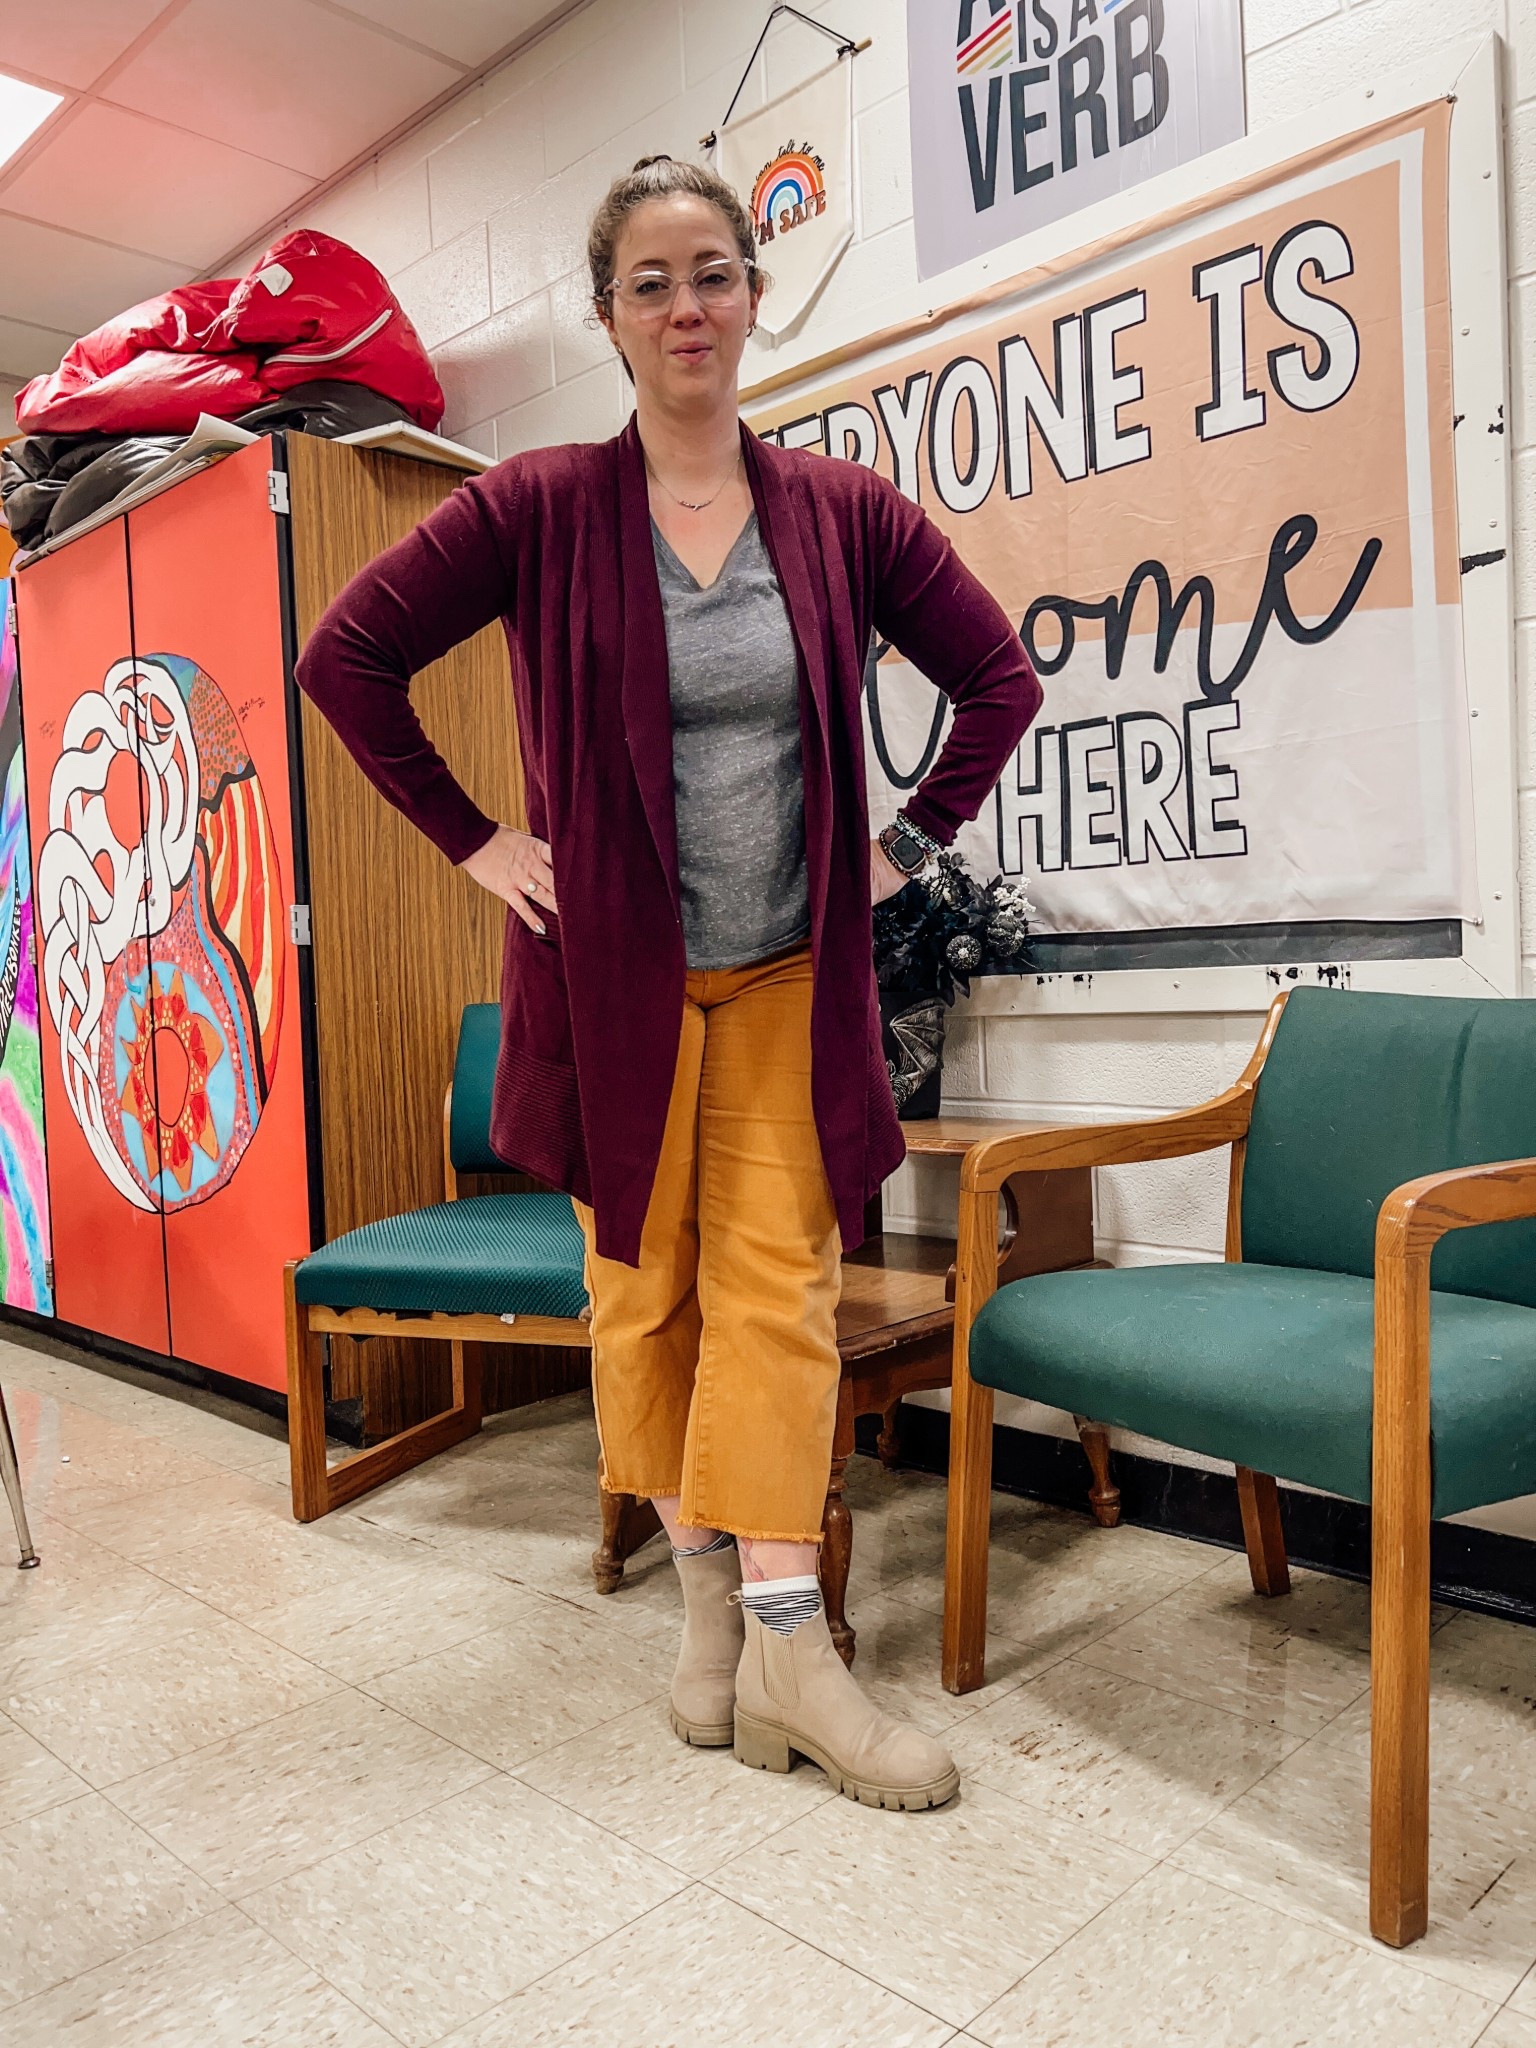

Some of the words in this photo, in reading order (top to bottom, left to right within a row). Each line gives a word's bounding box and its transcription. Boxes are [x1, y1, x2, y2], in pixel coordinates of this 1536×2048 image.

[776, 139, 795, 161] talk
[798, 142, 814, 155] to
[811, 155, 826, 172] me
[957, 0, 1170, 213] VERB
[780, 190, 826, 233] SAFE
[1192, 219, 1360, 443] IS
[997, 699, 1248, 876] HERE
